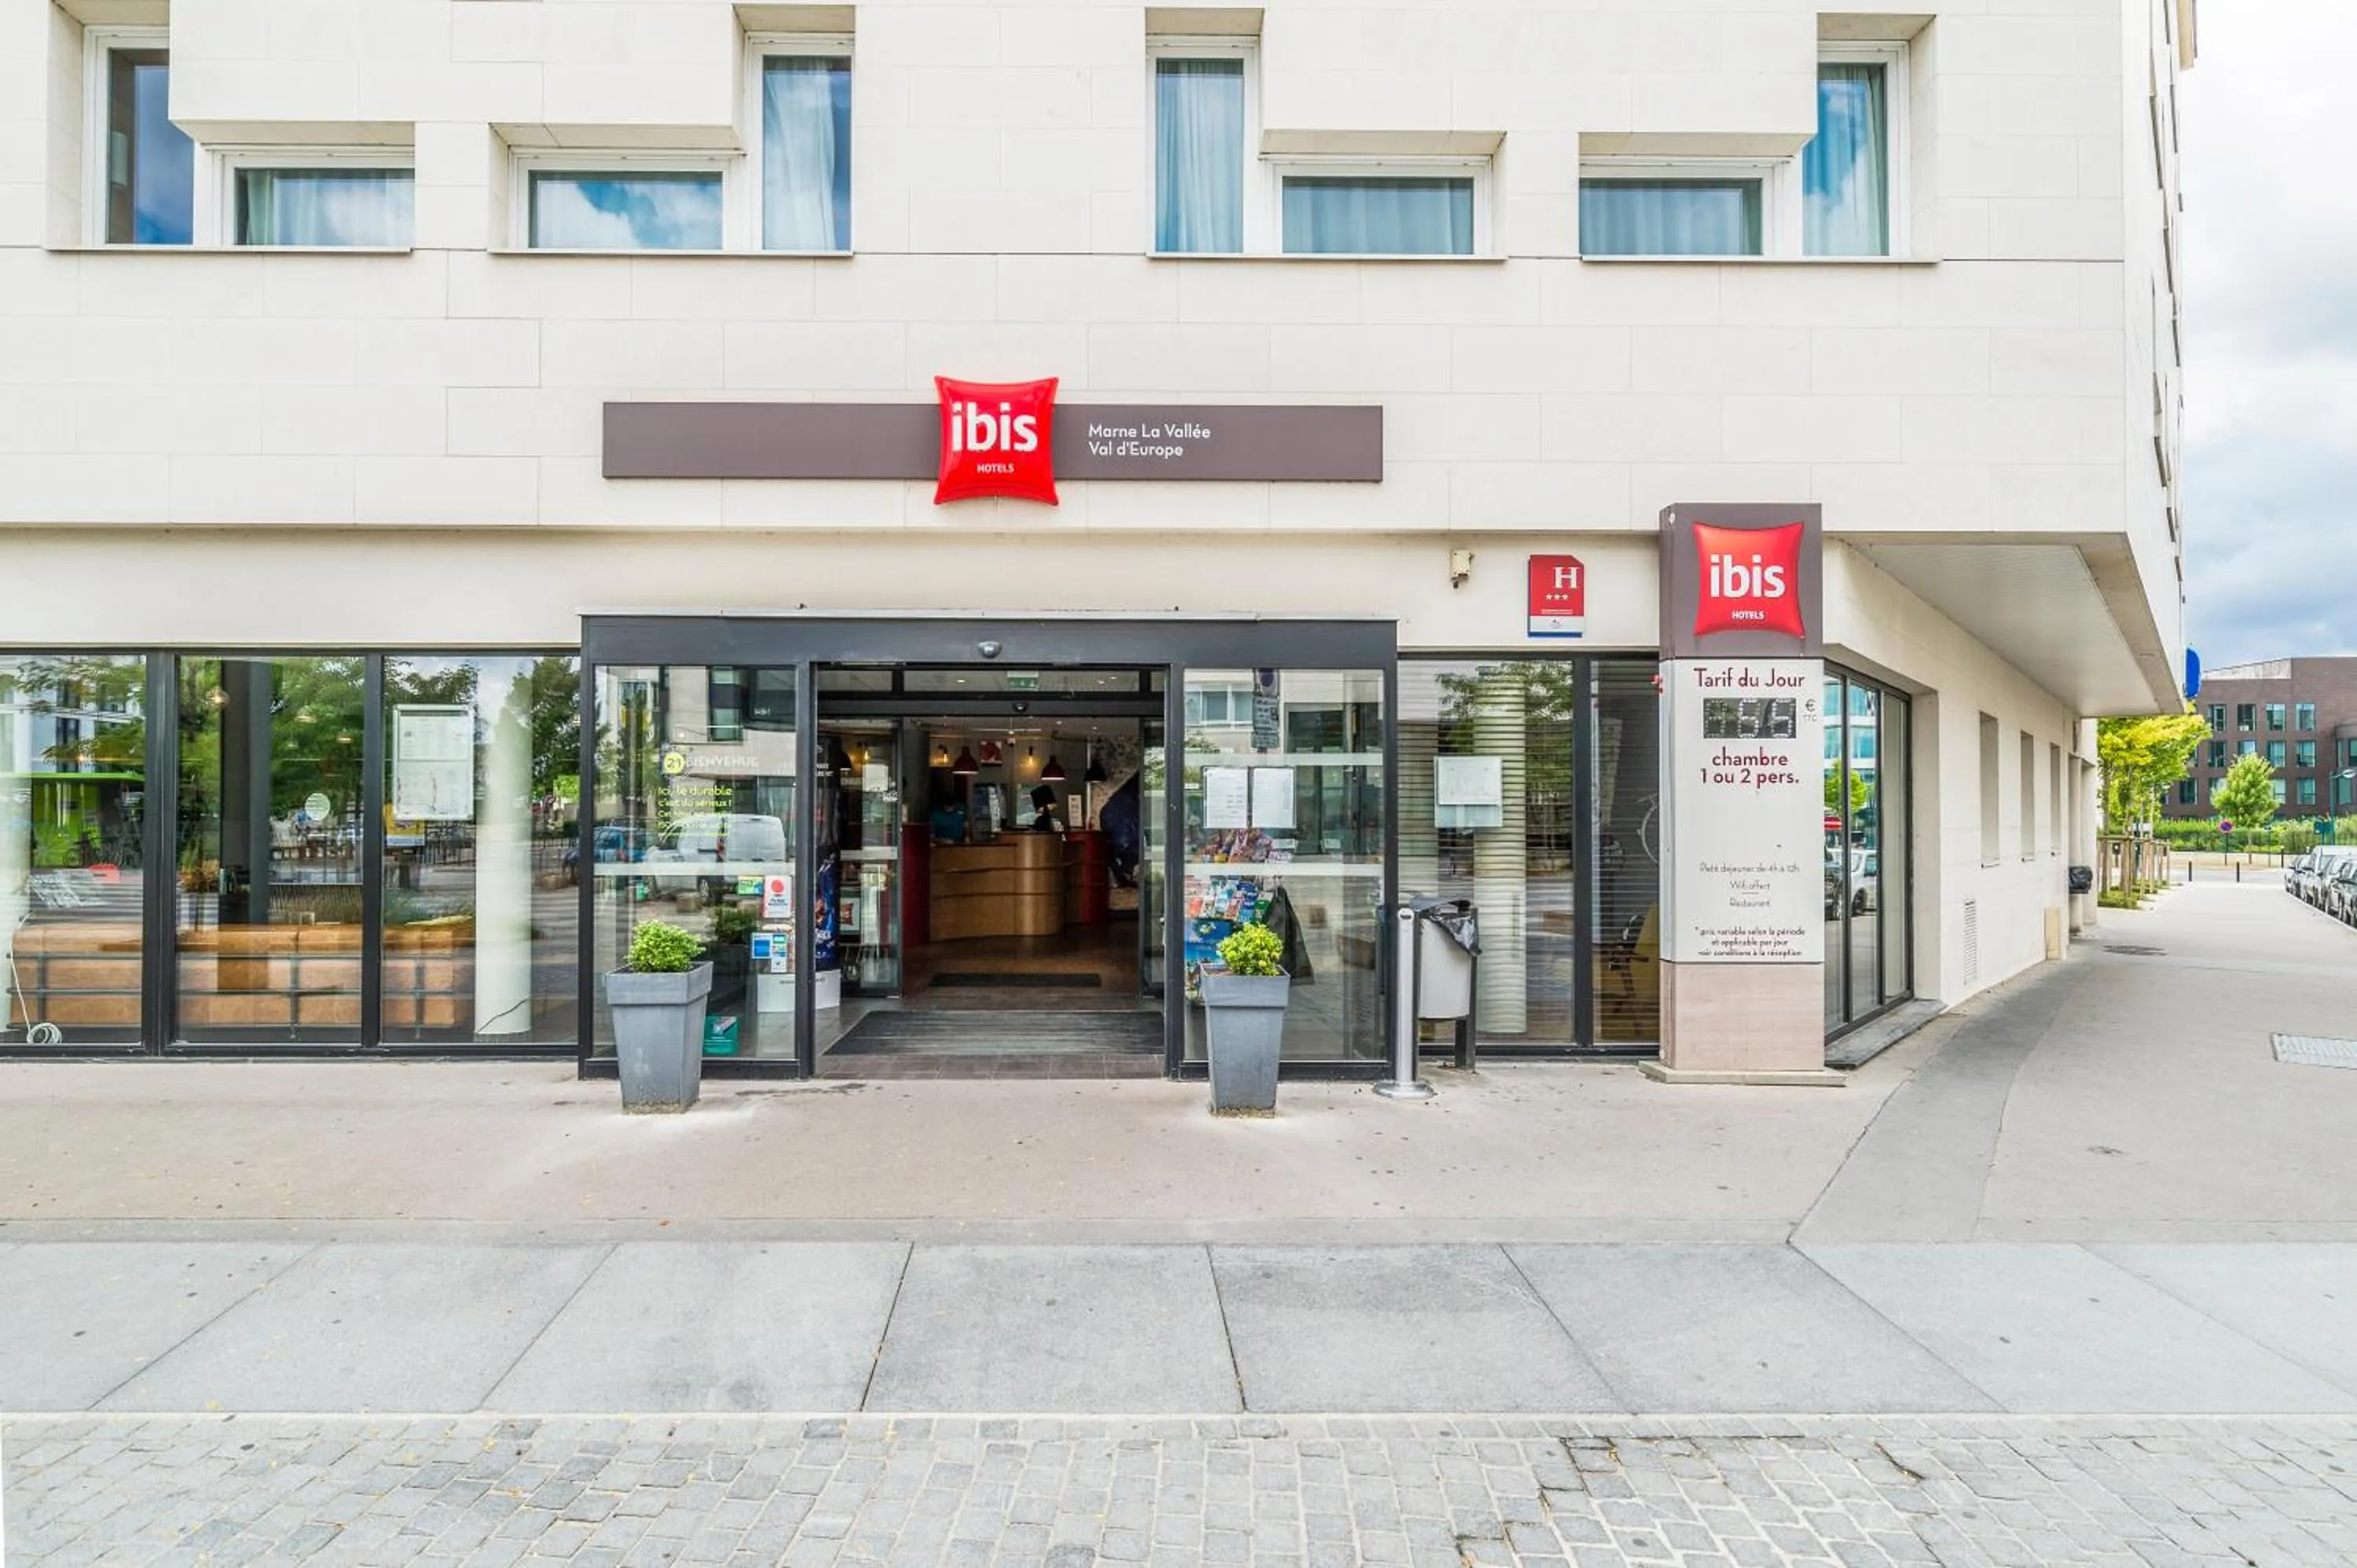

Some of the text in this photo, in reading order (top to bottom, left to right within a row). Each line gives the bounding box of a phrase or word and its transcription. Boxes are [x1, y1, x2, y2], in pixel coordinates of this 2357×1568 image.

[952, 401, 1038, 452] ibis
[1088, 423, 1211, 438] Marne La Vallée
[1089, 441, 1183, 459] Val d'Europe
[977, 463, 1014, 474] HOTELS
[1552, 566, 1582, 588] H
[1710, 554, 1785, 598] ibis
[1732, 611, 1765, 620] HOTELS
[1694, 668, 1805, 687] Tarif du Jour
[686, 756, 761, 768] BIENVENUE
[1712, 746, 1788, 766] chambre
[1701, 769, 1799, 789] 1 ou 2 pers.
